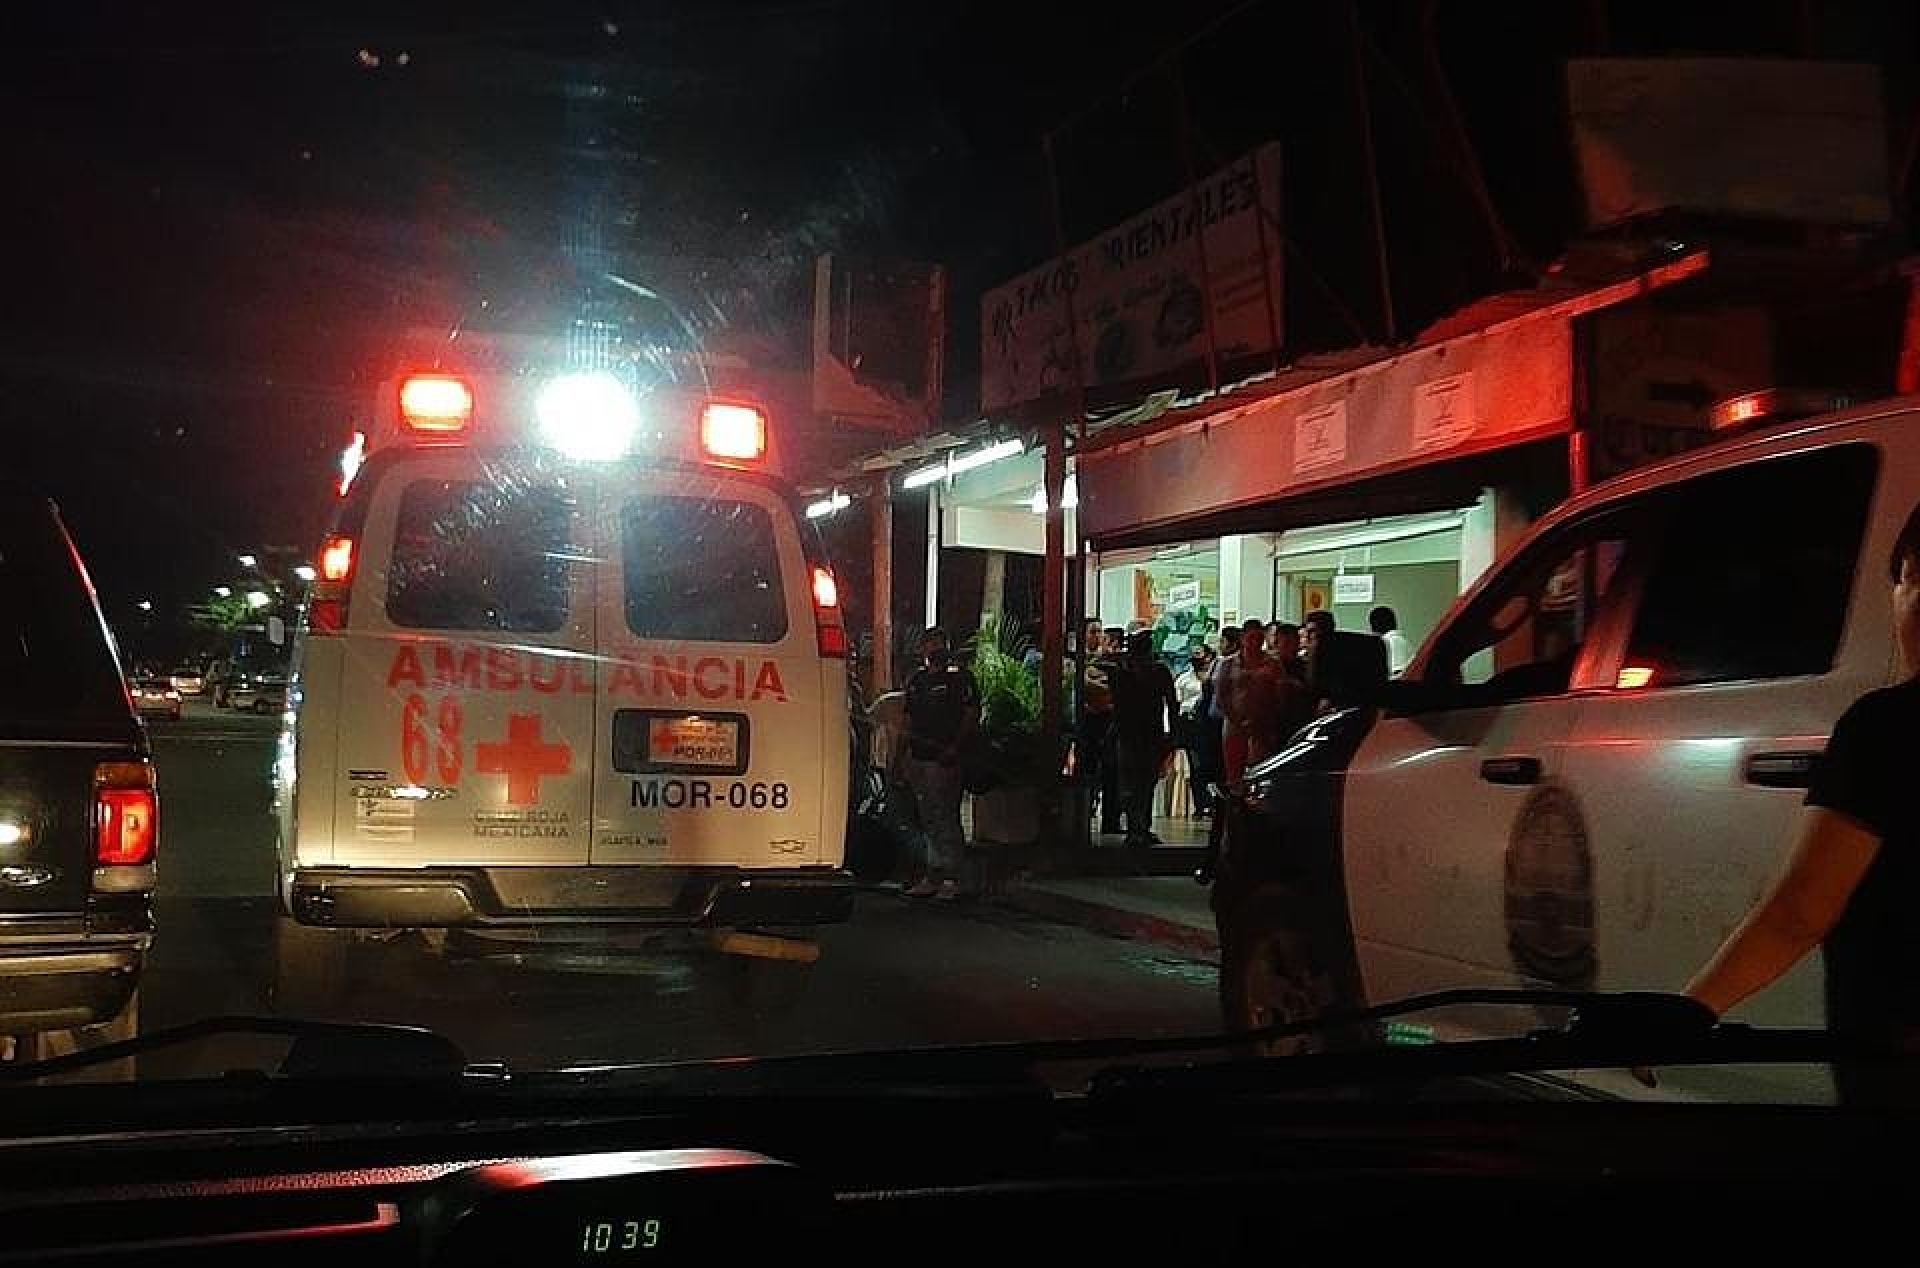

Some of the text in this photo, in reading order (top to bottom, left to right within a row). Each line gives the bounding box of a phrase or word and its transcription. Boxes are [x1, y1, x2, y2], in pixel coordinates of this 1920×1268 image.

[387, 643, 789, 703] AMBULANCIA
[402, 692, 464, 786] 68
[630, 779, 790, 809] MOR-068
